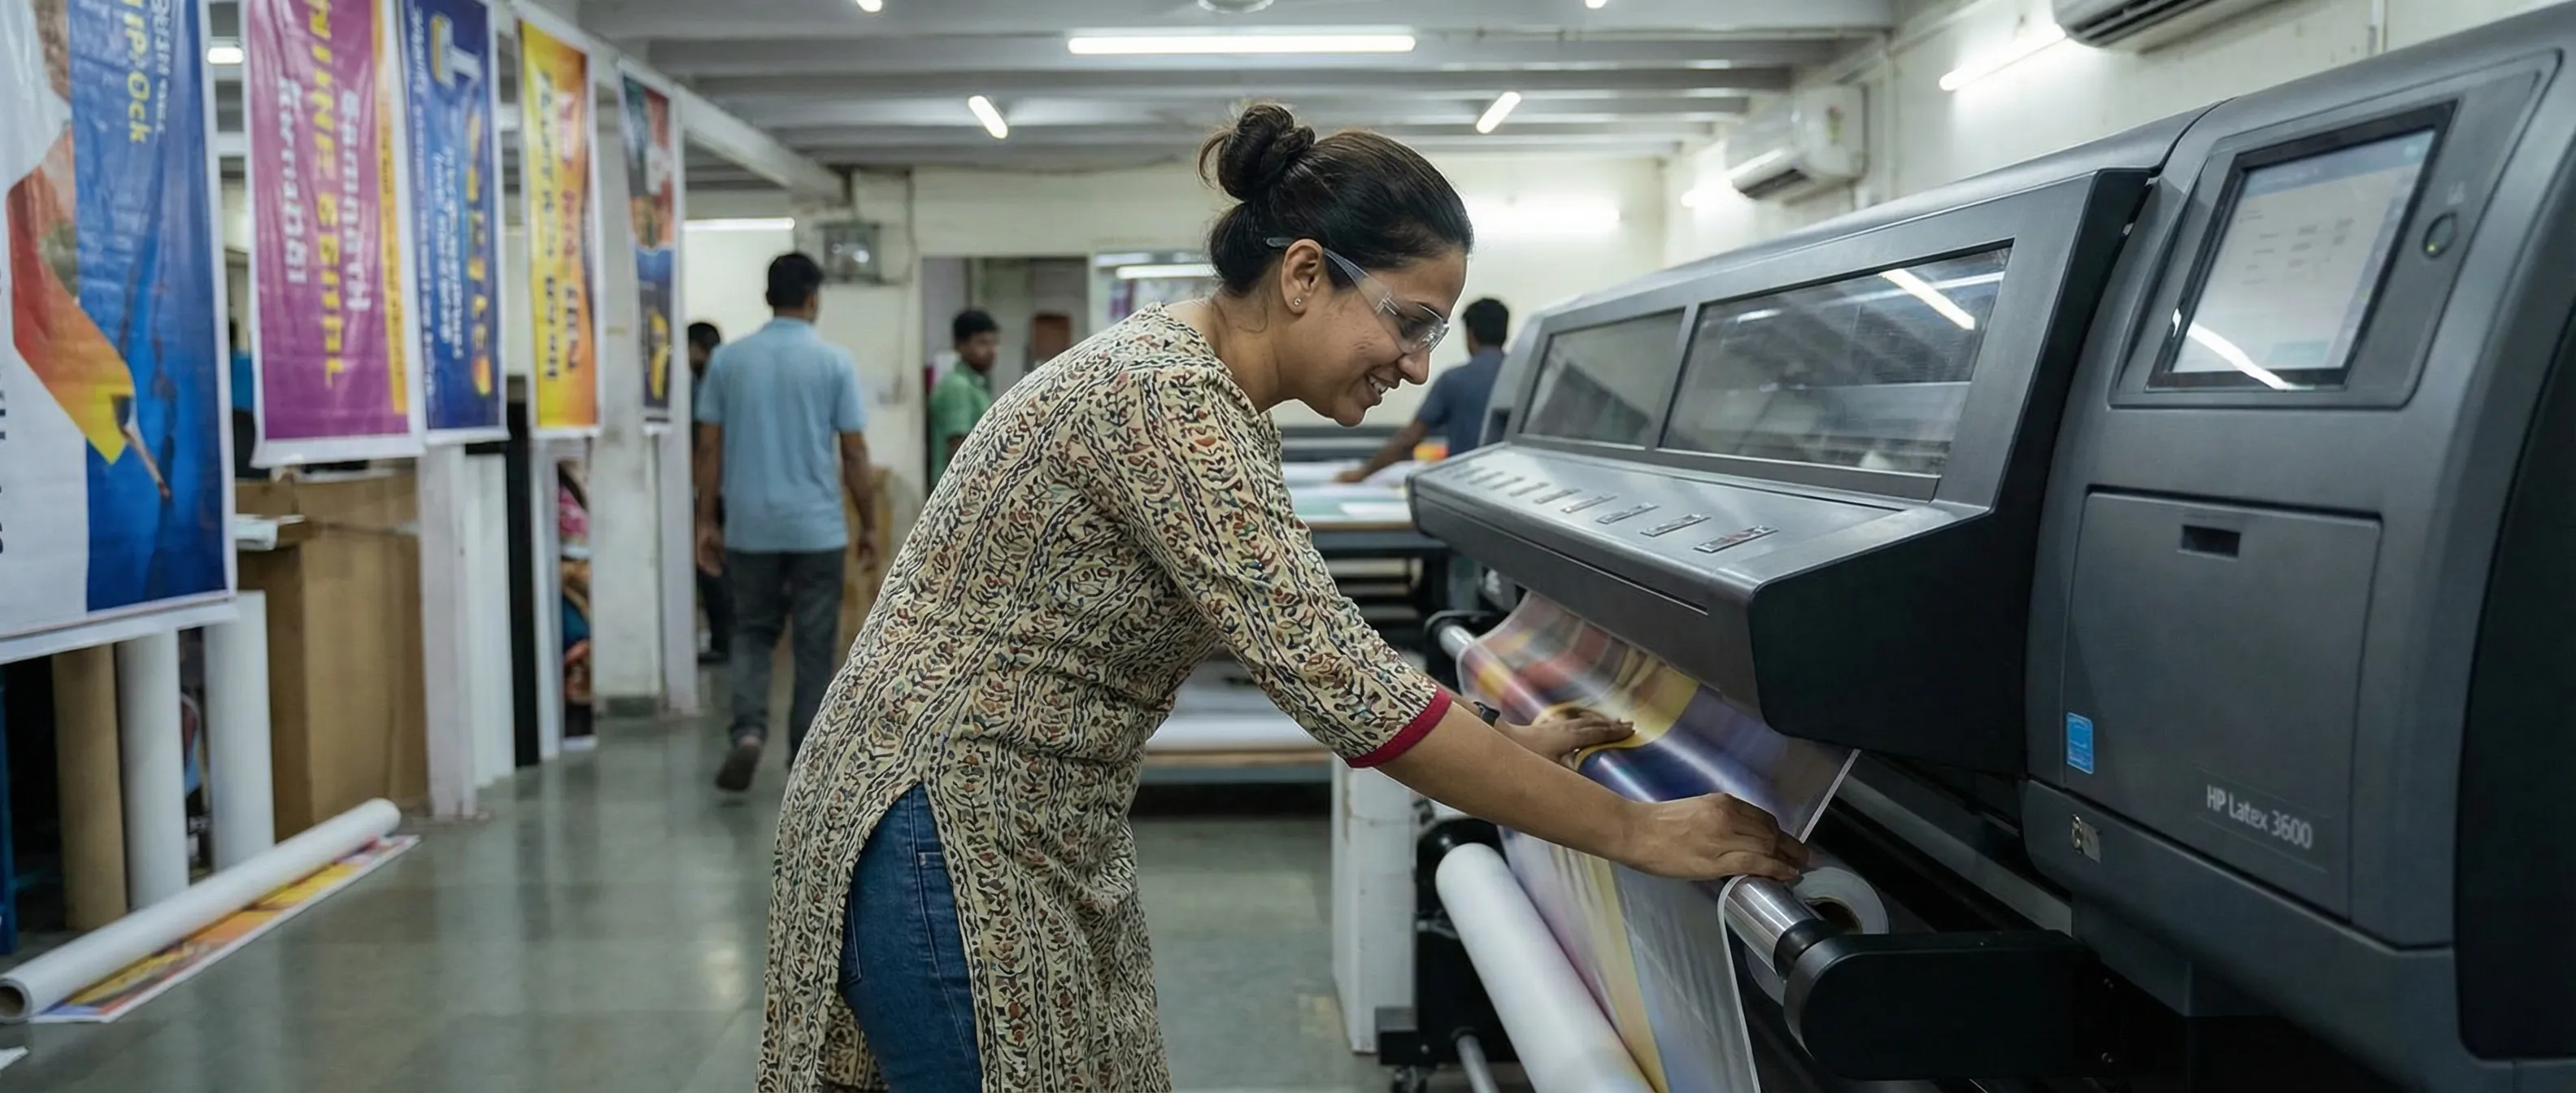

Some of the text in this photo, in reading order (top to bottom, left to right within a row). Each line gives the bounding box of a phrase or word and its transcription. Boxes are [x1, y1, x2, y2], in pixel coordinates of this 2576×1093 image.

[2206, 784, 2313, 850] HP Latex 3600
